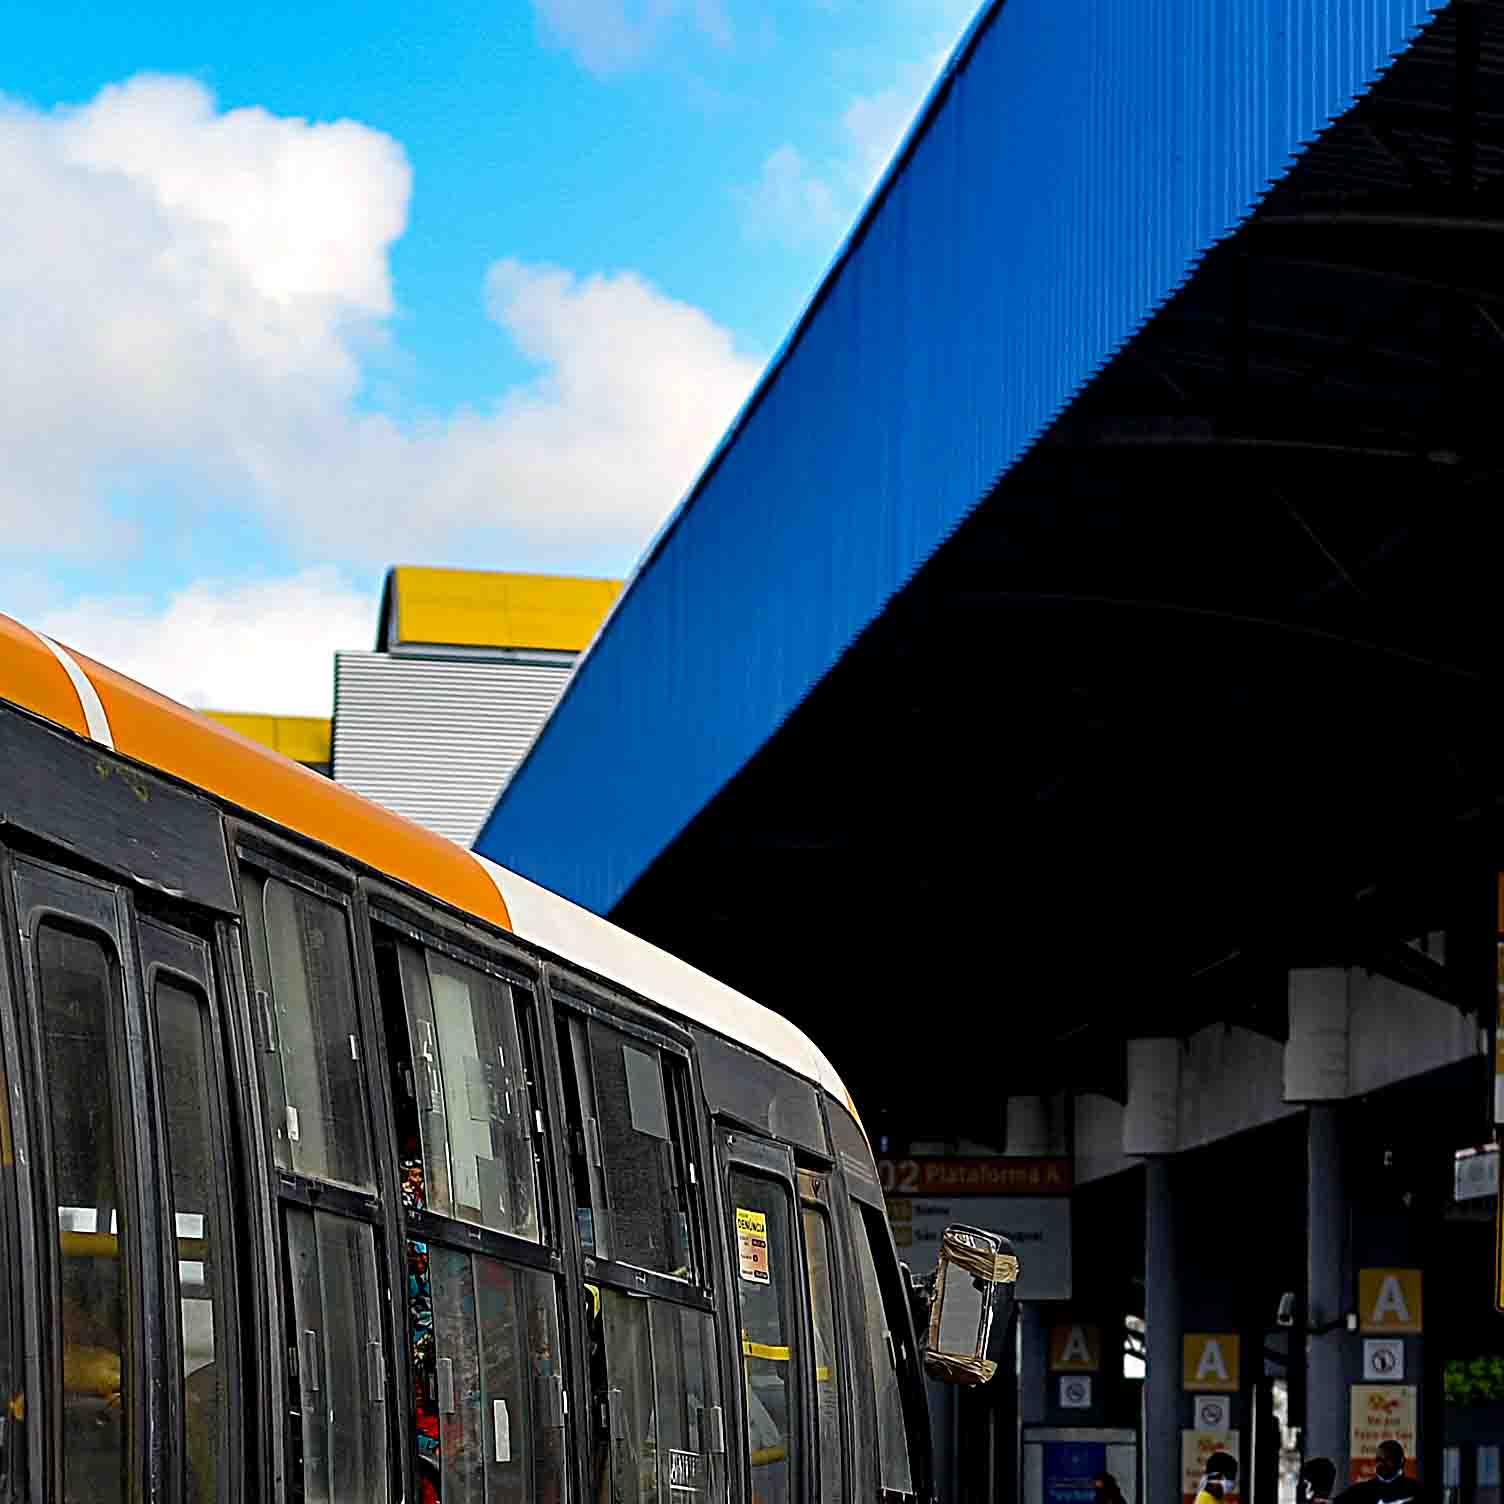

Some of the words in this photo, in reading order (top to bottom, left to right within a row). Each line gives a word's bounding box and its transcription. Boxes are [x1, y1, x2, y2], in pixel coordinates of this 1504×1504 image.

[1372, 1274, 1409, 1323] A
[1060, 1322, 1093, 1363] A
[1194, 1337, 1229, 1380] A
